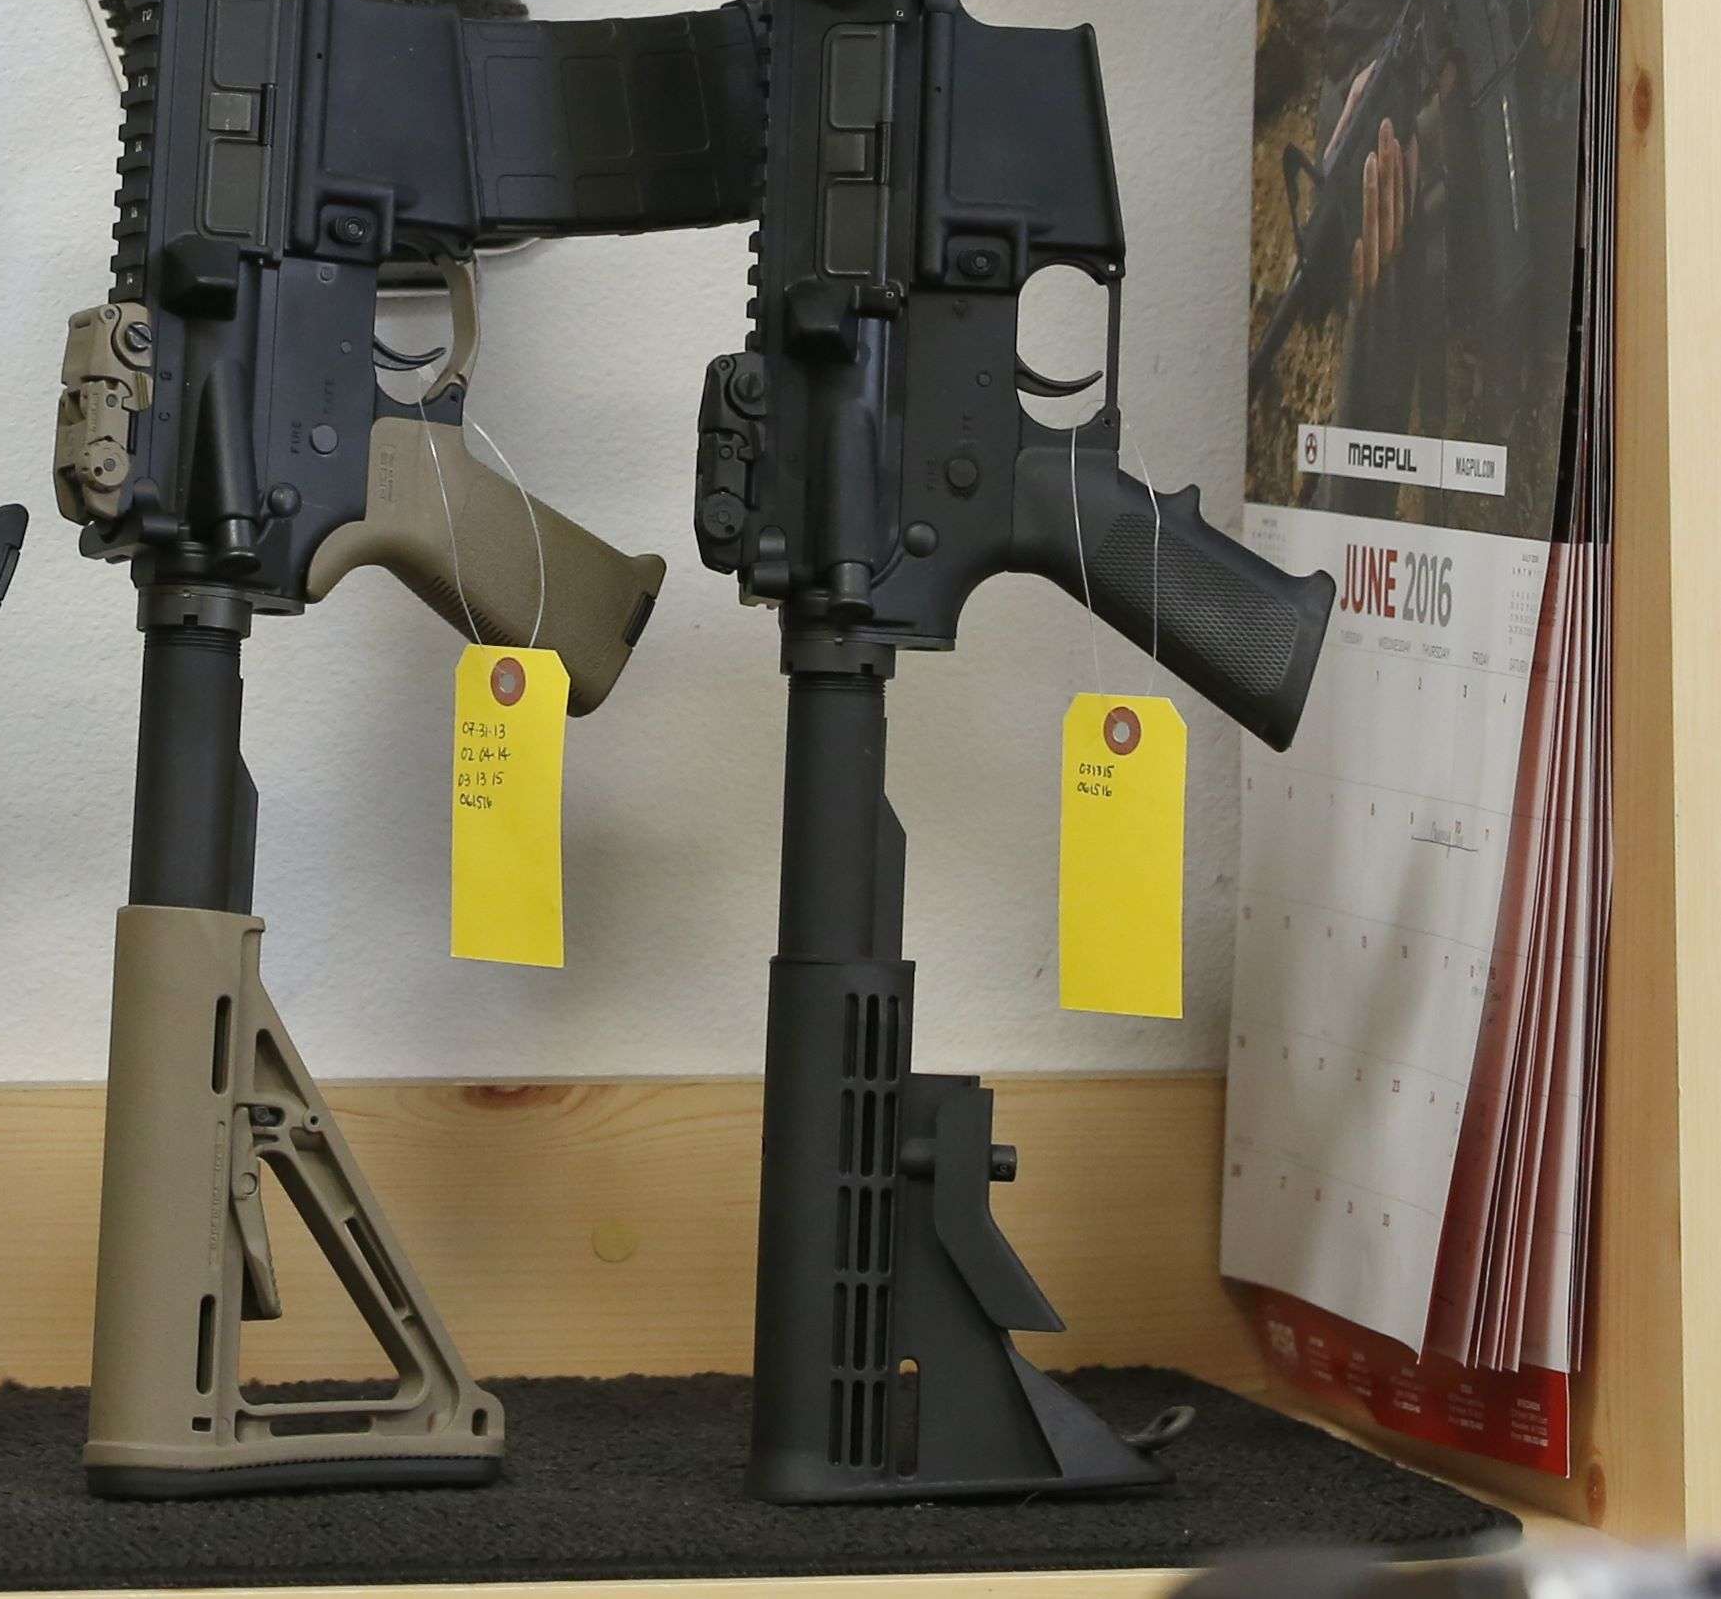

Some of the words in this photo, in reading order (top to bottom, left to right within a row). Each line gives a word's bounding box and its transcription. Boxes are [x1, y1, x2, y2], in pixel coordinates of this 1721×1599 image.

[1348, 442, 1417, 472] MAGPUL
[1339, 544, 1398, 619] JUNE
[1402, 551, 1453, 627] 2016
